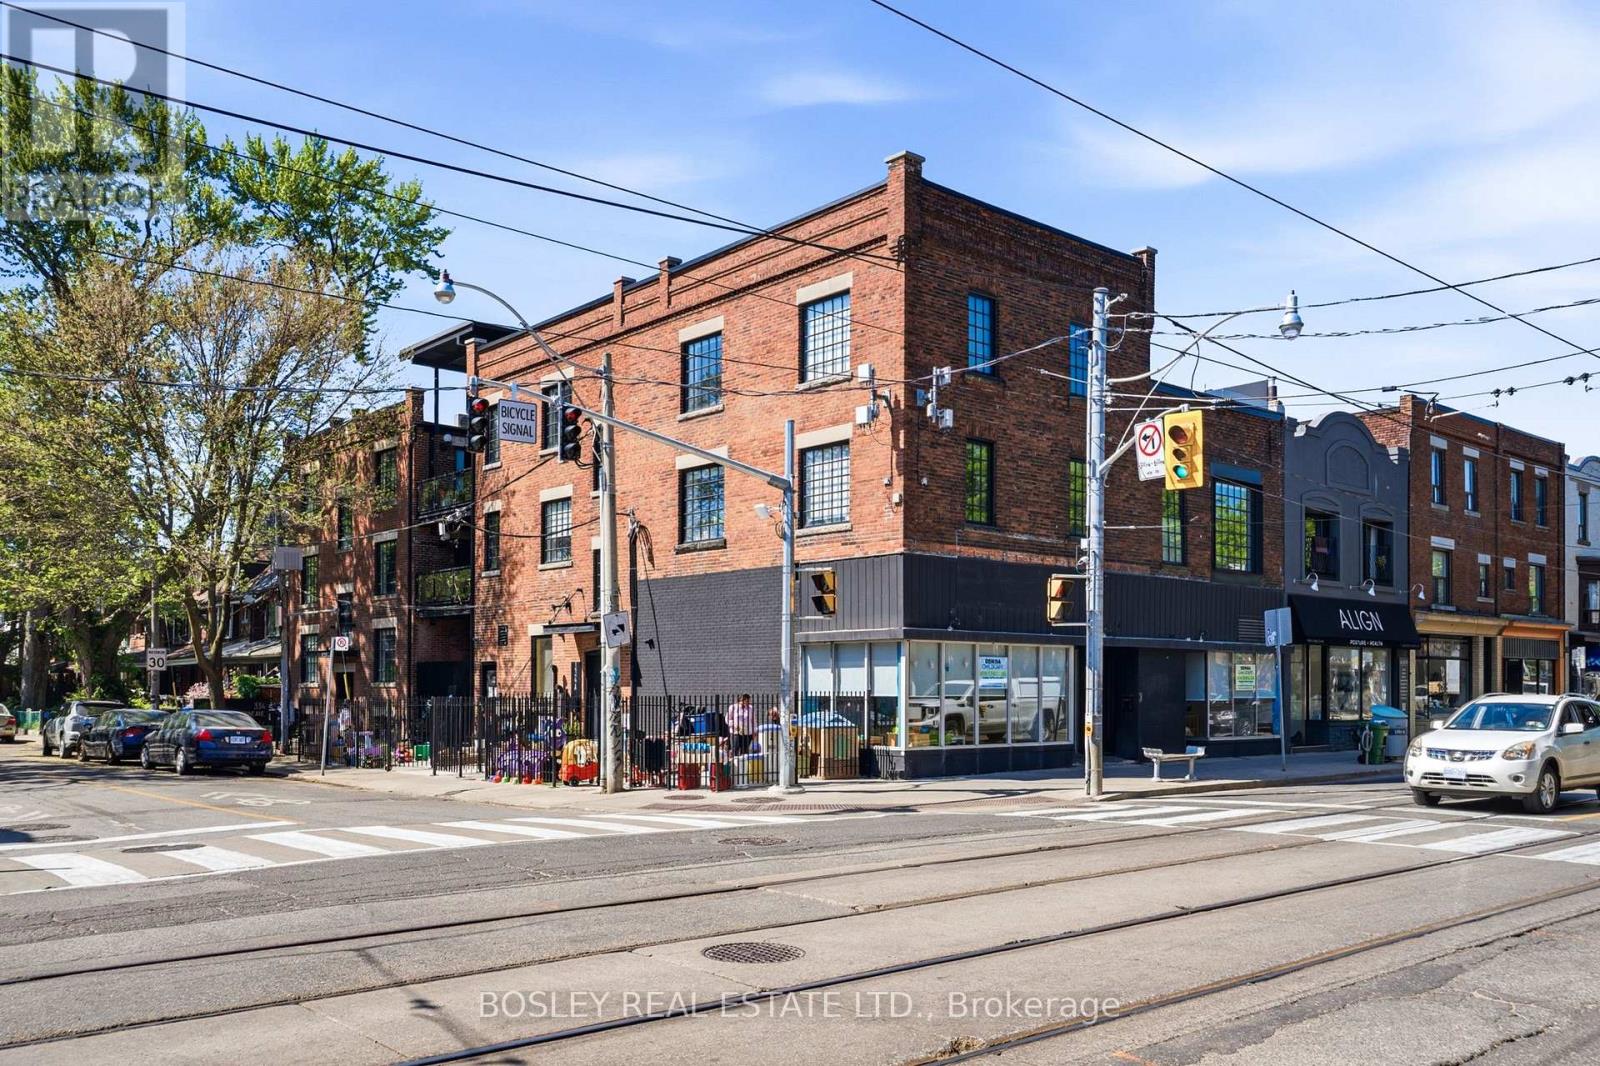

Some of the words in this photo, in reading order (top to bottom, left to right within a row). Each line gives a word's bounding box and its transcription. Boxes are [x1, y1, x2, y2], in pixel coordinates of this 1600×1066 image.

[501, 405, 535, 421] BICYCLE
[502, 422, 534, 438] SIGNAL
[1339, 608, 1384, 631] ALIGN
[149, 657, 165, 668] 30
